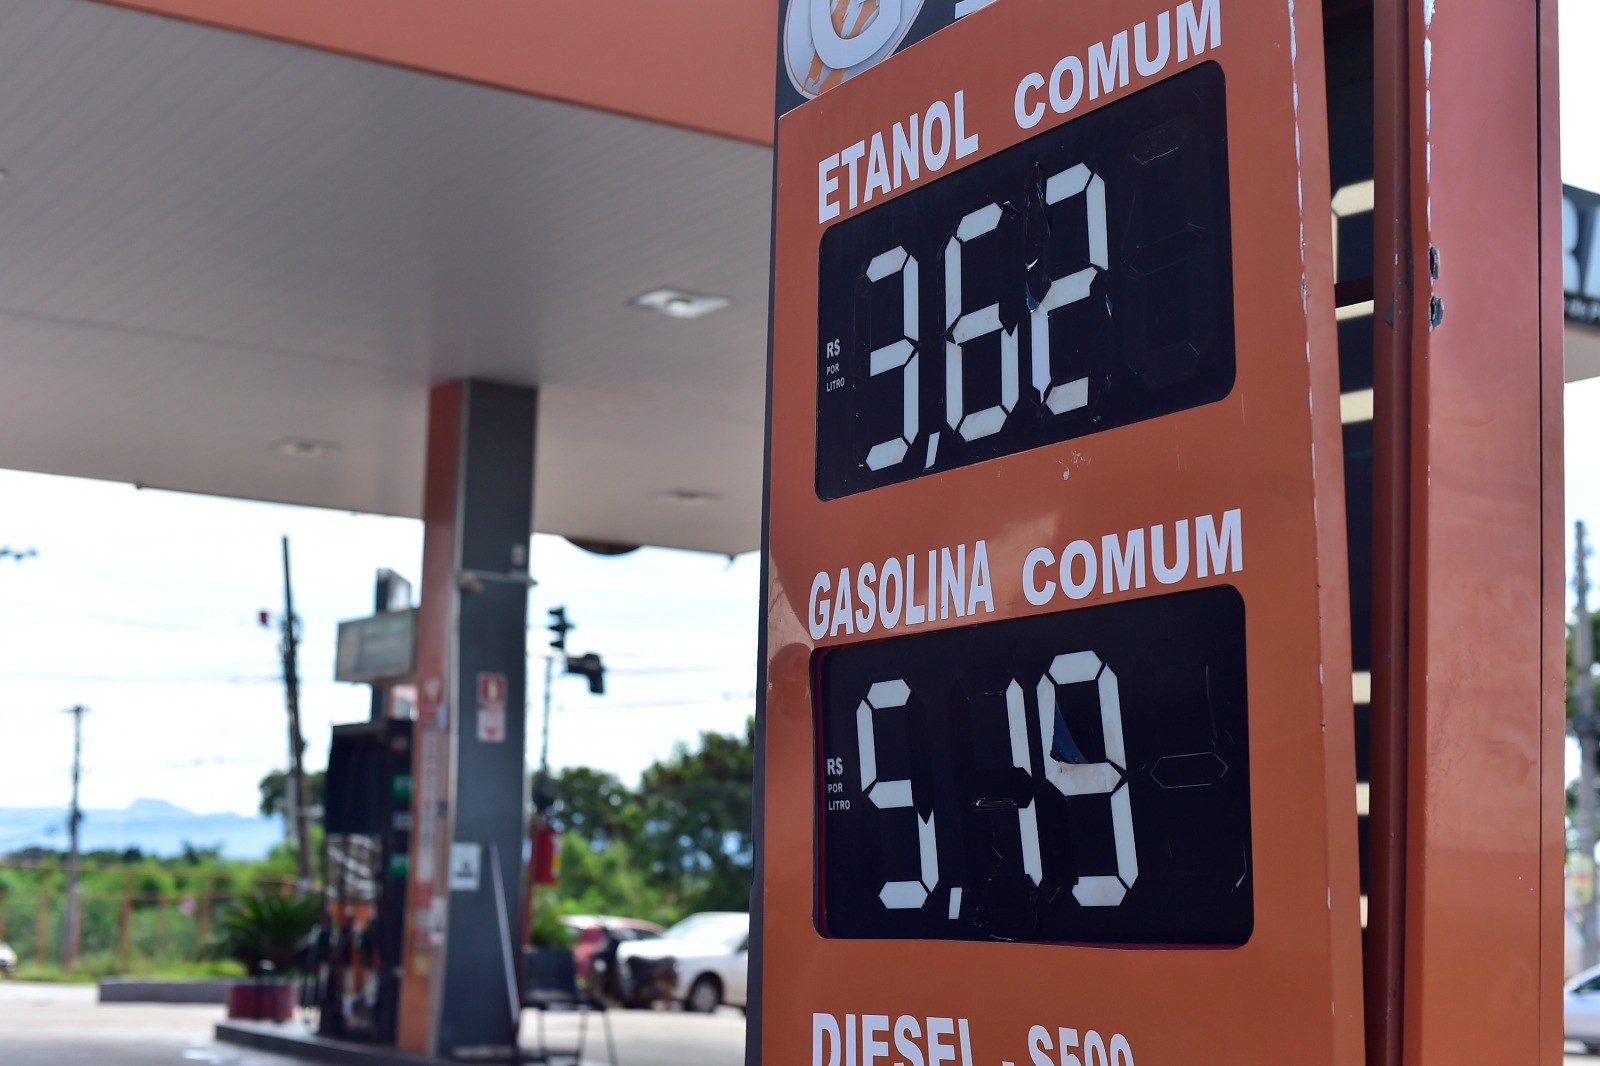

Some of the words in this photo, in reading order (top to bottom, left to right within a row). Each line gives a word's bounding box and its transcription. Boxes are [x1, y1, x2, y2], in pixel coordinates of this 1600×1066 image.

[818, 89, 979, 224] ETANOL
[1014, 0, 1222, 129] COMUM
[865, 162, 1109, 472] 3,62
[826, 363, 840, 376] POR
[826, 377, 845, 392] LITRO
[809, 539, 995, 640] GASOLINA
[1022, 508, 1244, 607] COMUM
[827, 757, 844, 776] R$
[828, 783, 844, 793] POR
[856, 650, 1139, 920] 5,19
[828, 800, 851, 811] LITRO
